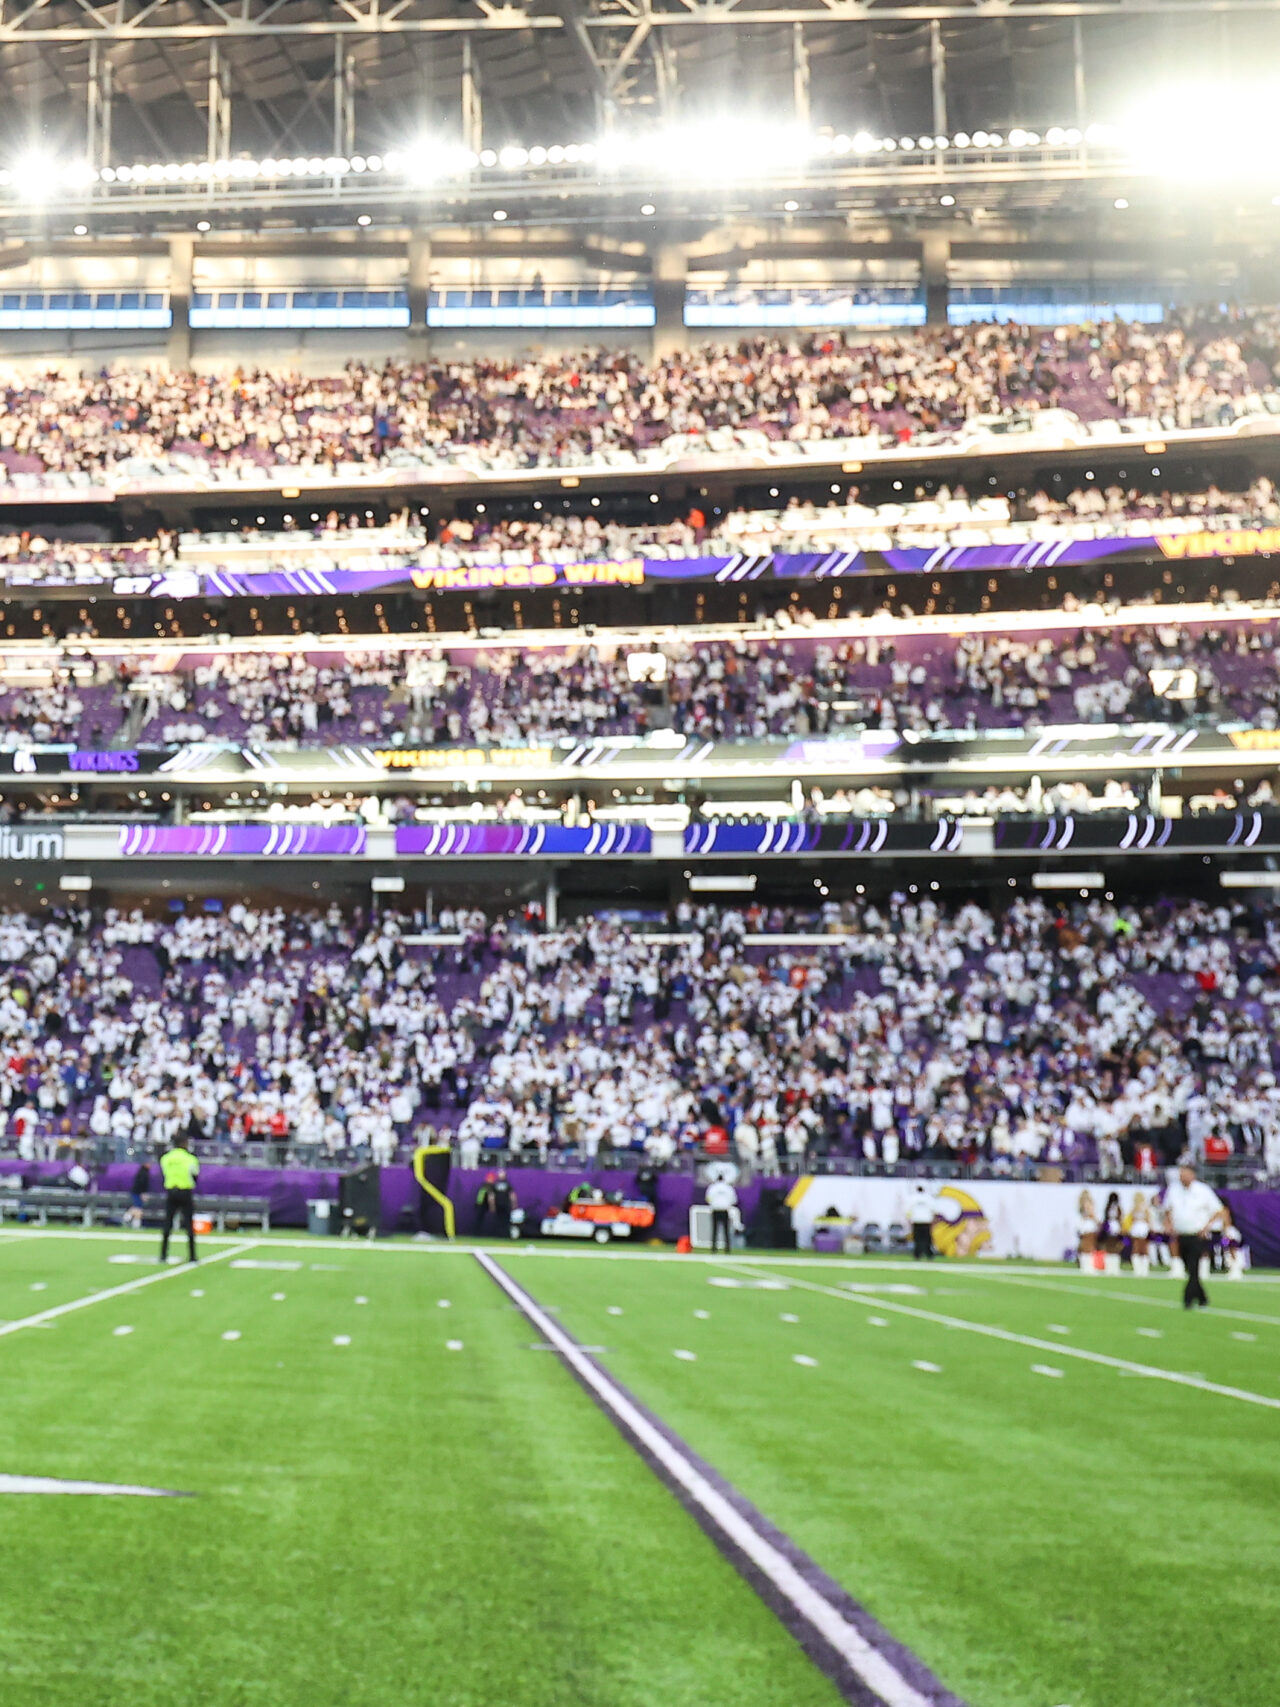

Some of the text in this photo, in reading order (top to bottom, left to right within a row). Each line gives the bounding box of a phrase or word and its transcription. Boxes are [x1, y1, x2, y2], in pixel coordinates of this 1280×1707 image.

[410, 559, 644, 588] VIKINGS WIN!
[374, 749, 486, 768] VIKINGS
